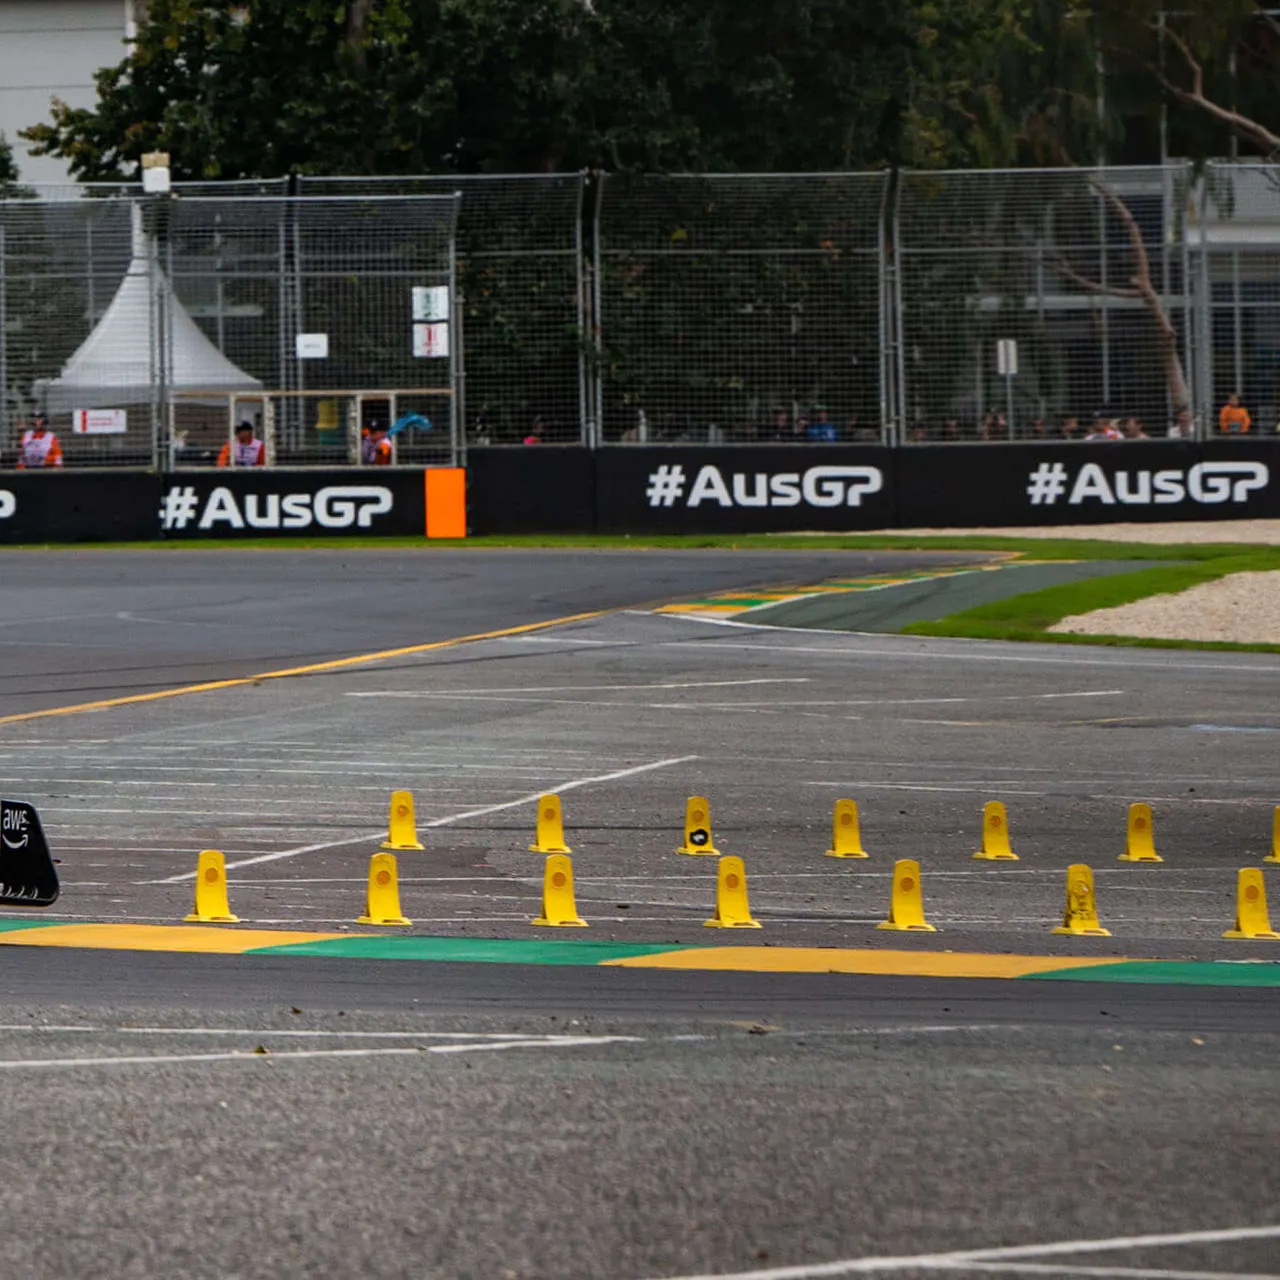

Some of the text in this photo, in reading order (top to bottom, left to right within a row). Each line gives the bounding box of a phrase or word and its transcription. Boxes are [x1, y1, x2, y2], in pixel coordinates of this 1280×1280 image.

[646, 465, 882, 507] #AusGP
[1027, 461, 1269, 504] #AusGP
[159, 486, 393, 529] #AusGP
[3, 809, 28, 831] aws
